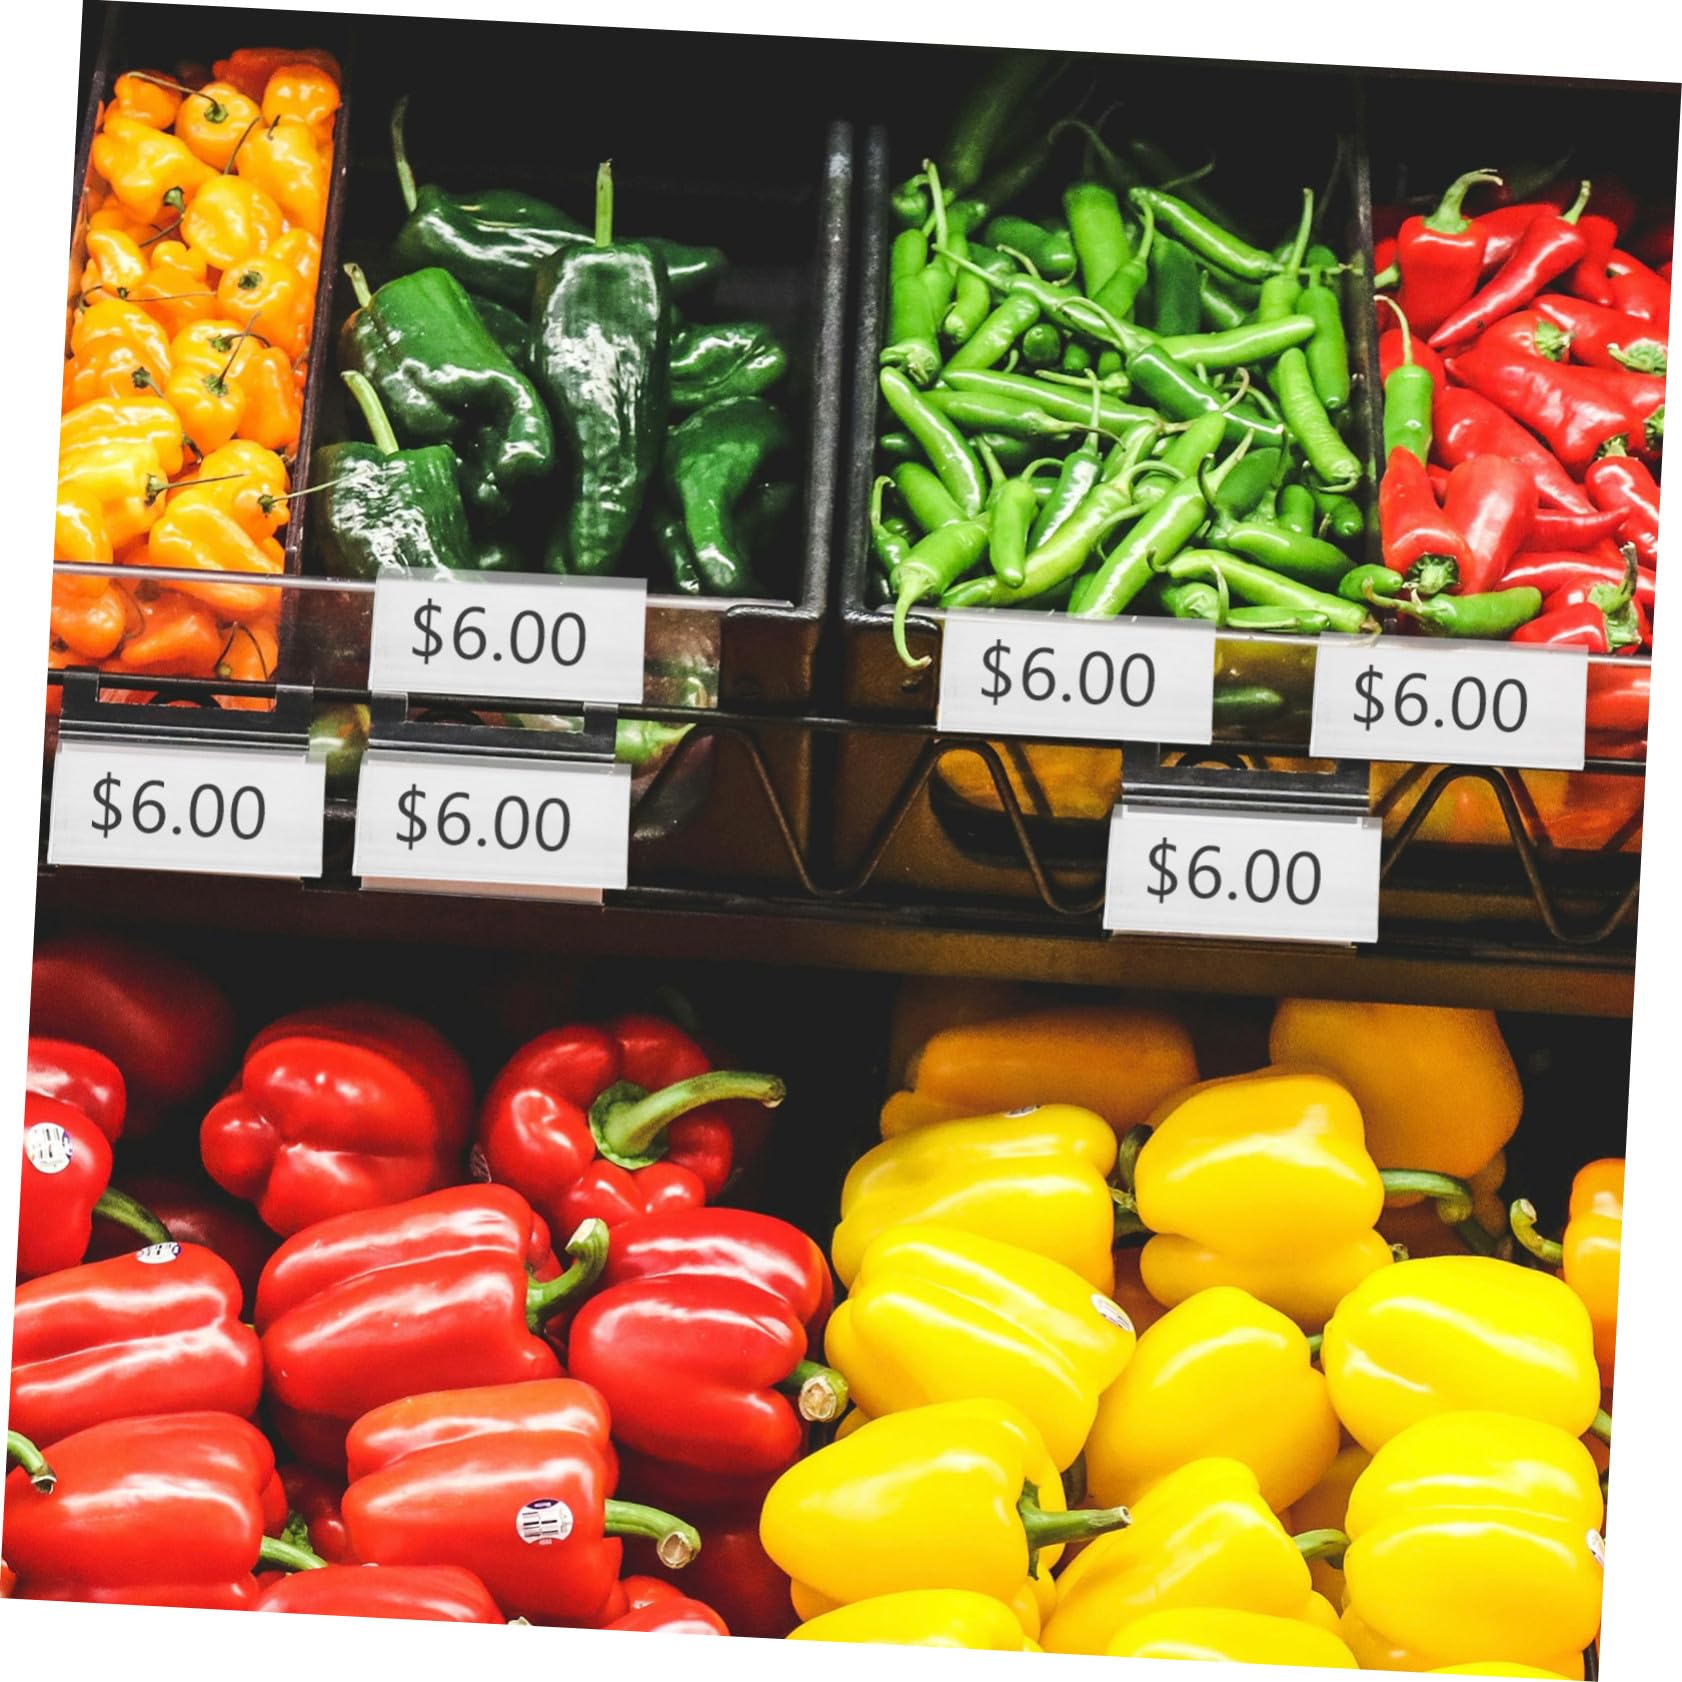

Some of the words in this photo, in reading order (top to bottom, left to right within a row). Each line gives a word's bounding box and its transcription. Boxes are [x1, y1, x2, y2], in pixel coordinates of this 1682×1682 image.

[411, 597, 586, 667] $6.00
[981, 638, 1155, 708] $6.00
[1353, 664, 1528, 733] $6.00
[91, 771, 266, 840] $6.00
[396, 783, 571, 852] $6.00
[1147, 836, 1321, 906] $6.00
